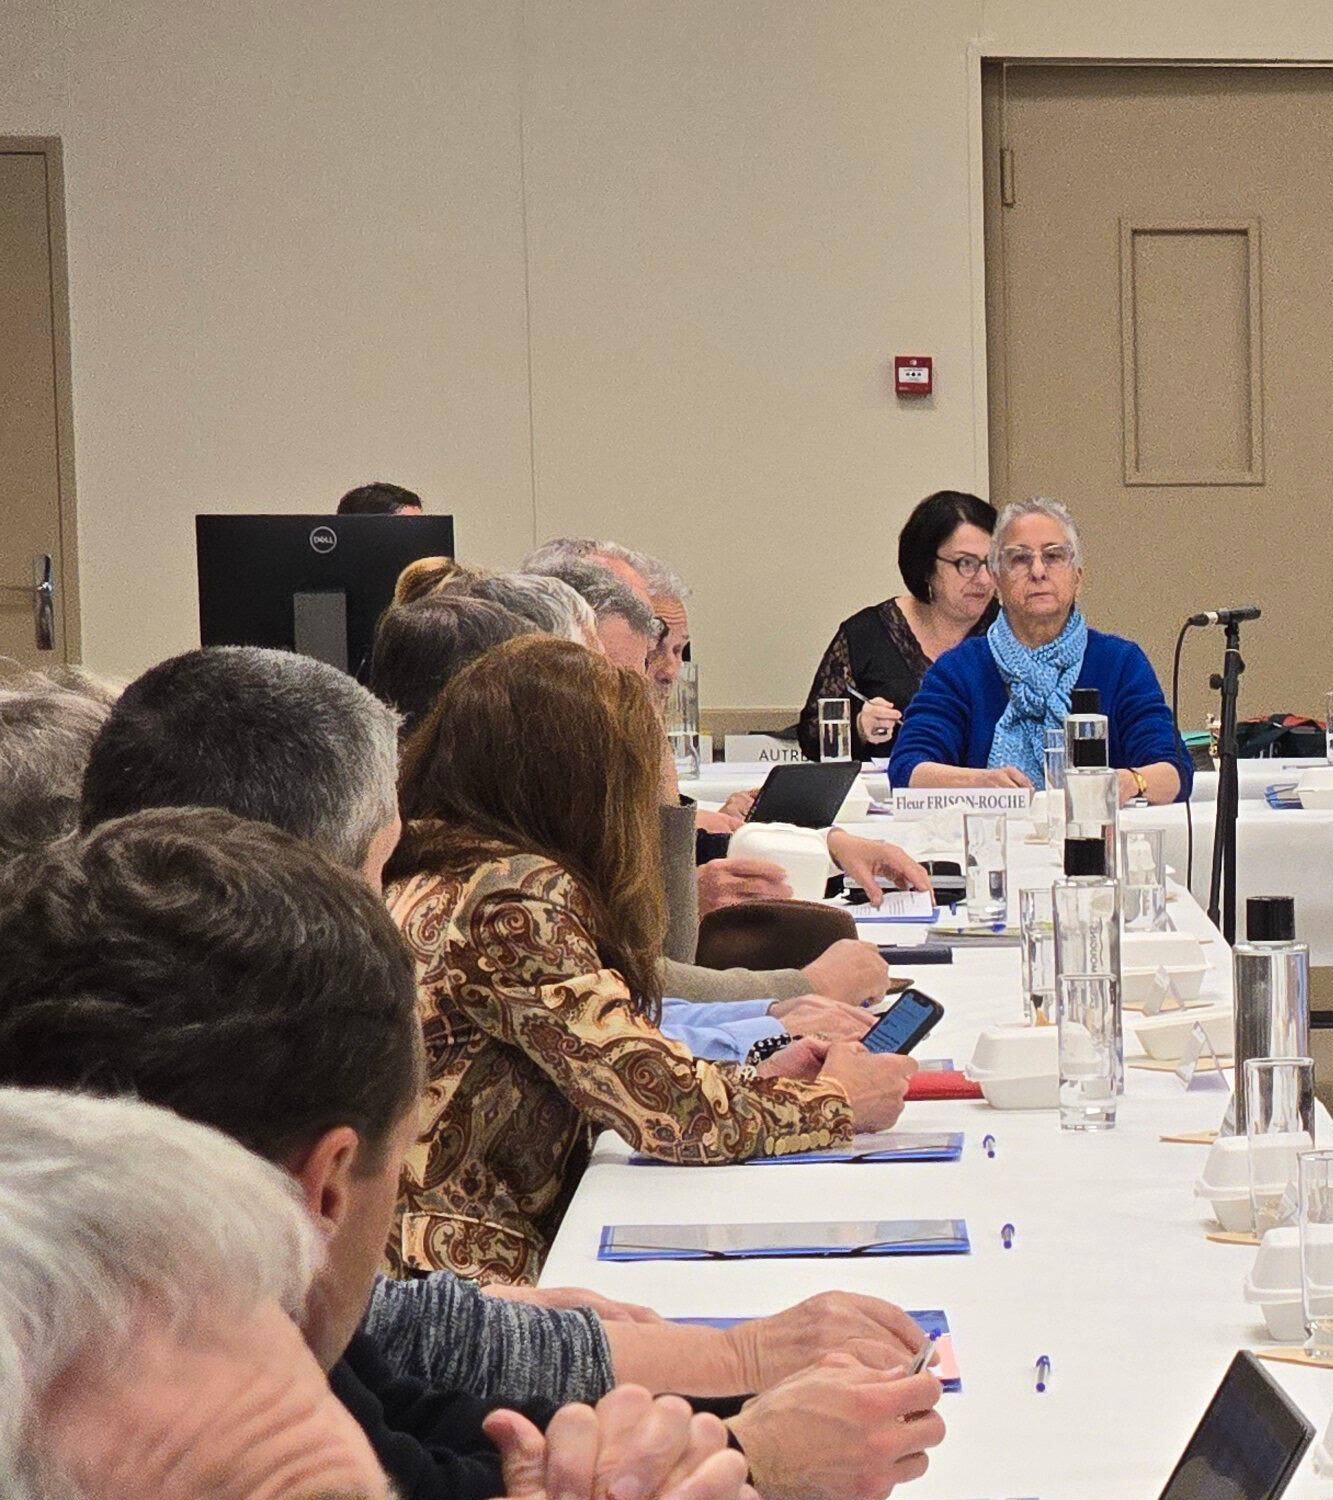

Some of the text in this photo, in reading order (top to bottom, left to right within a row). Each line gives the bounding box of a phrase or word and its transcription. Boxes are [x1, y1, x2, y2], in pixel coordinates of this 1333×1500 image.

[313, 535, 334, 544] DELL
[896, 794, 1025, 810] Fleur FRISON-ROCHE
